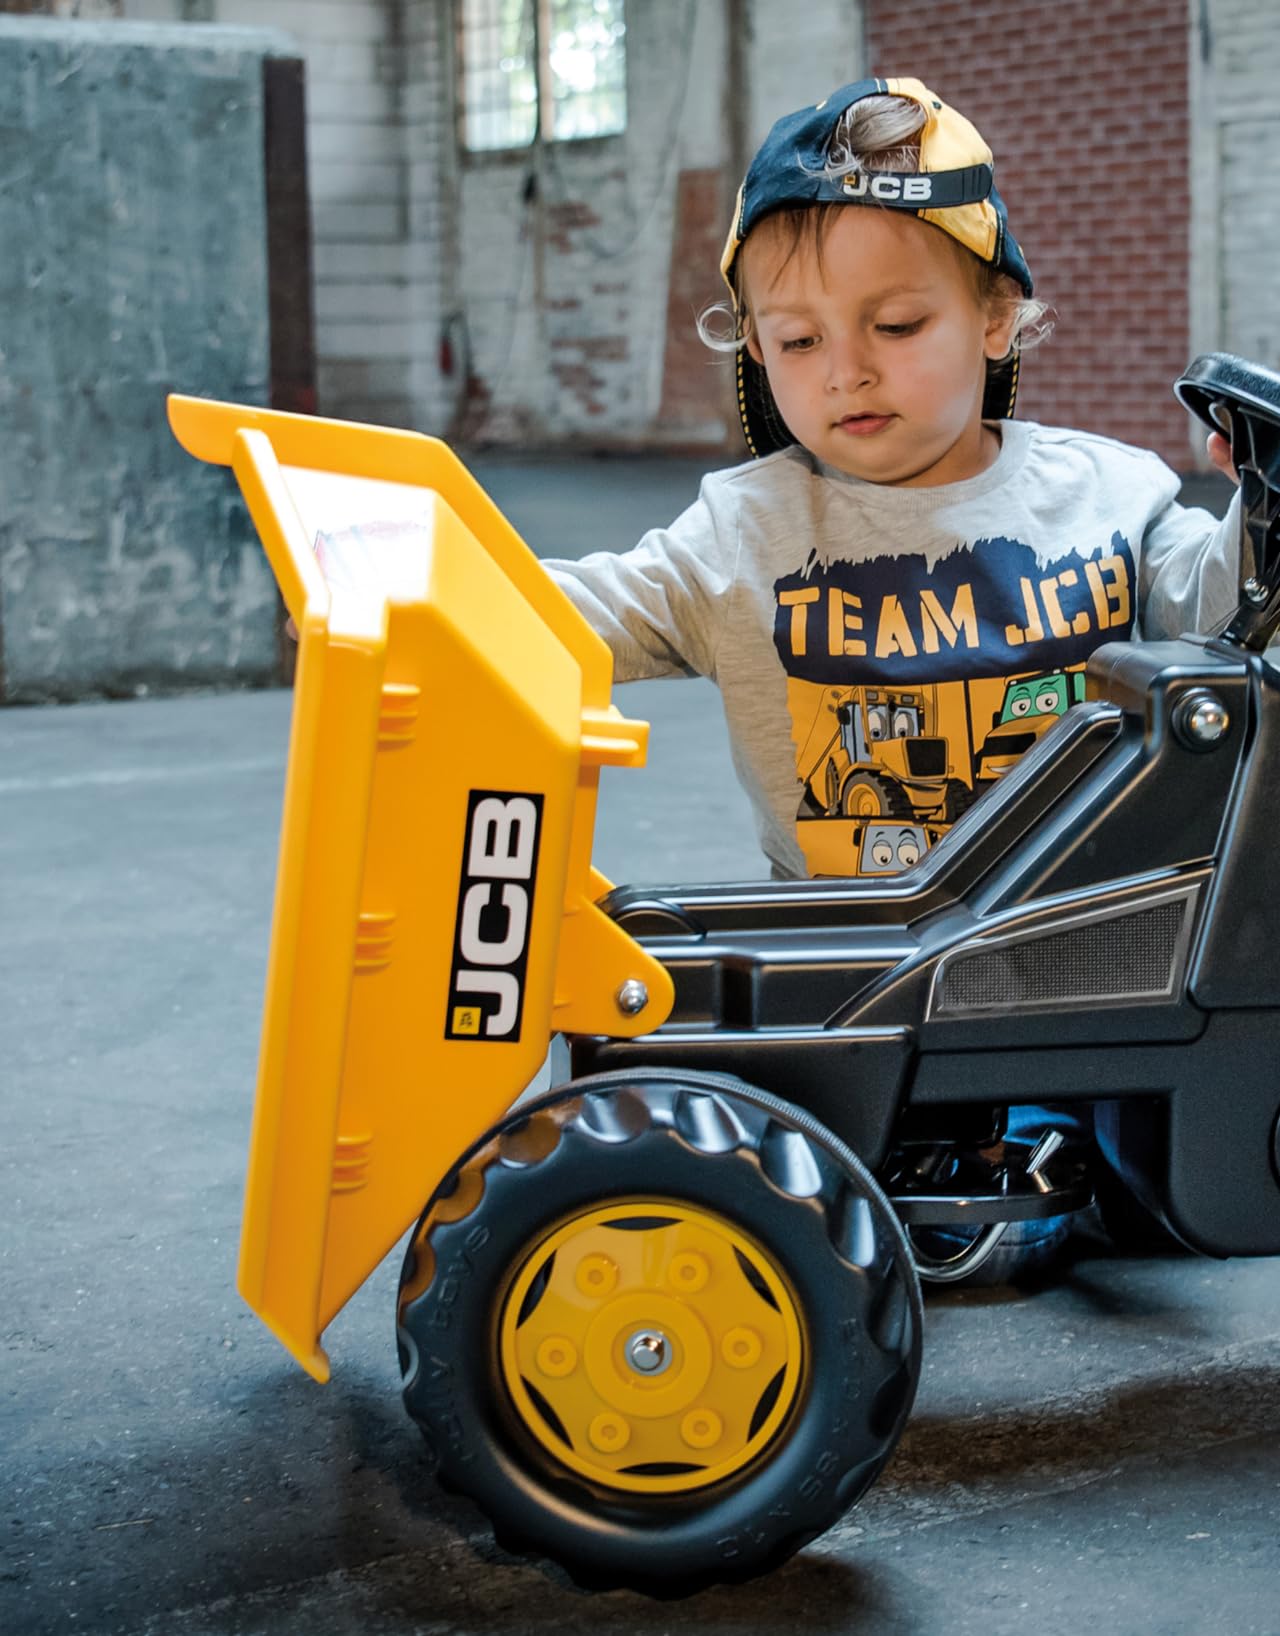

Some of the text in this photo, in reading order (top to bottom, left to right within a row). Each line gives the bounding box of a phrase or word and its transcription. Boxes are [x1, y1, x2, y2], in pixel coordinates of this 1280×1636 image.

[843, 175, 932, 201] JCB
[779, 554, 1131, 659] TEAM JCB
[455, 797, 537, 1036] JCB
